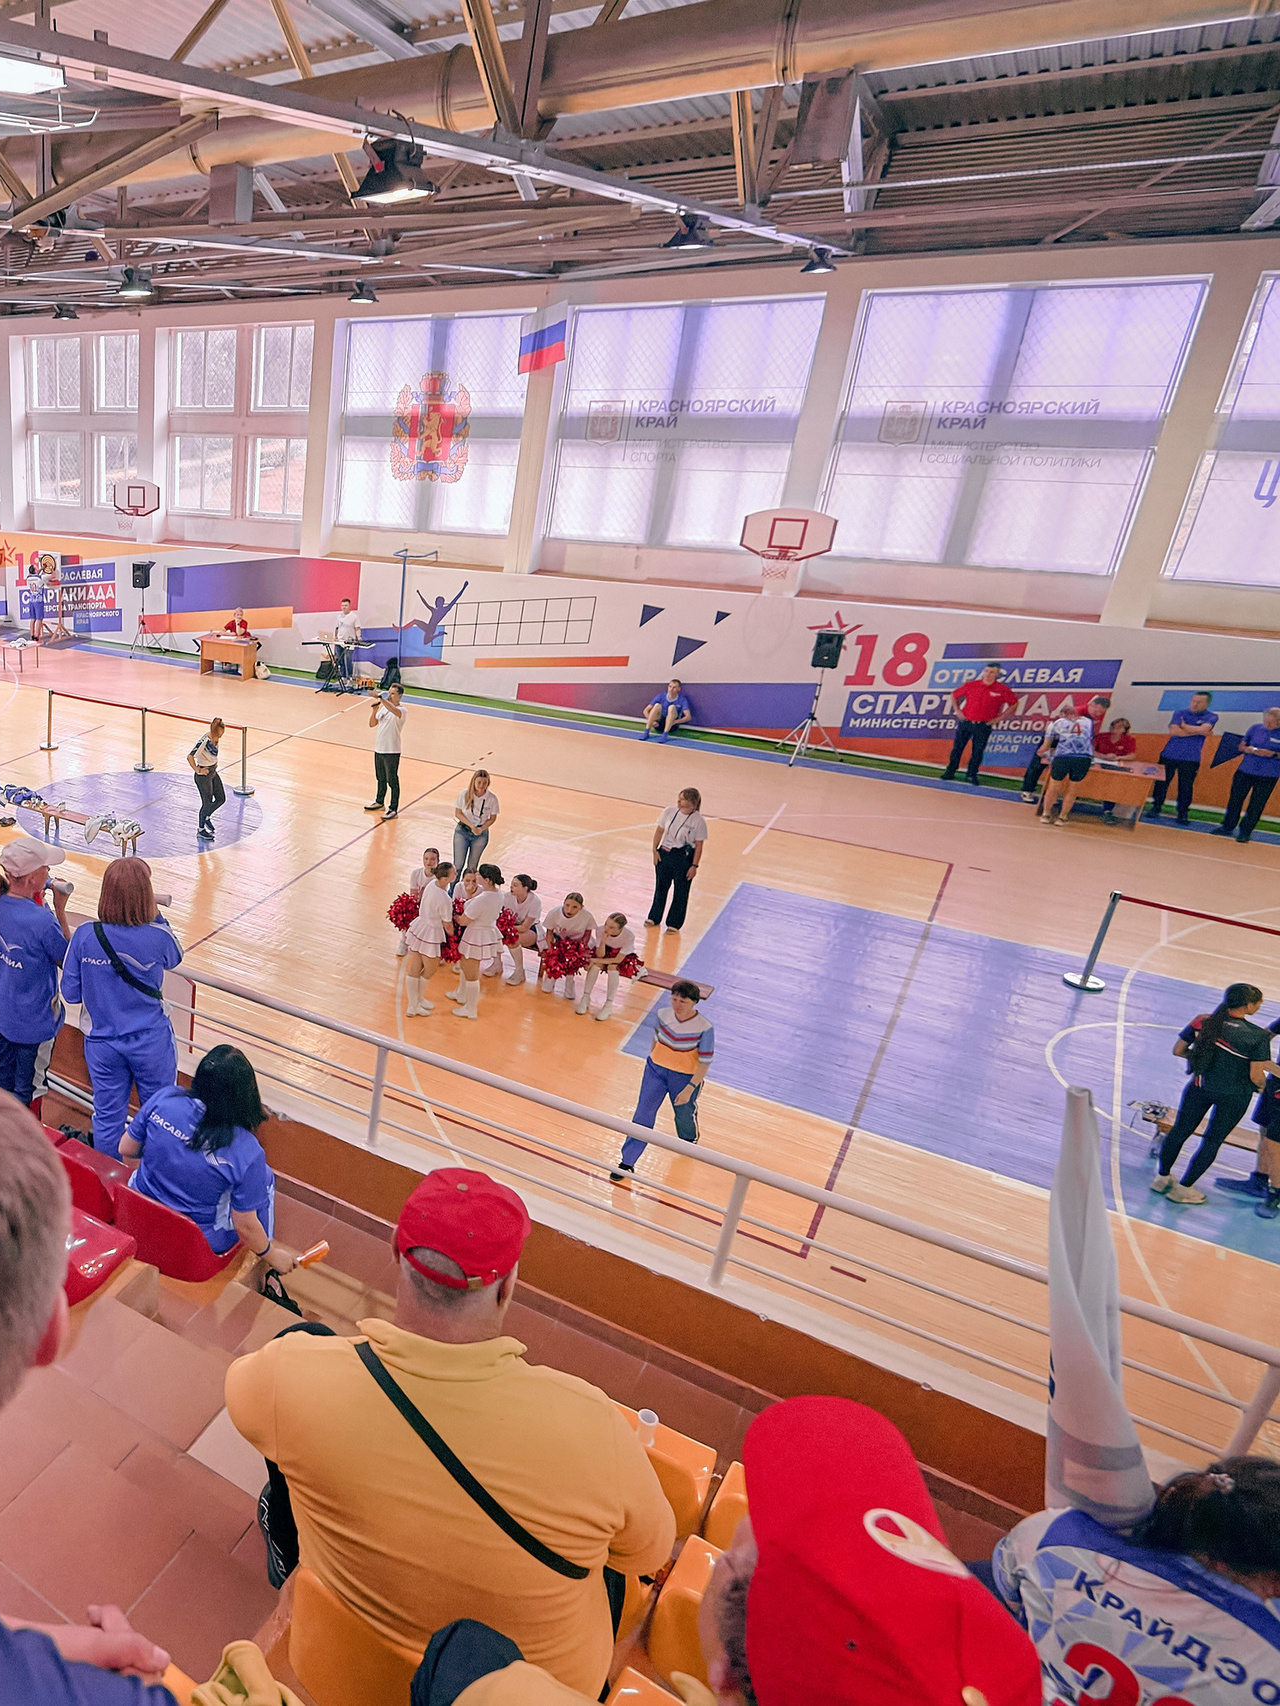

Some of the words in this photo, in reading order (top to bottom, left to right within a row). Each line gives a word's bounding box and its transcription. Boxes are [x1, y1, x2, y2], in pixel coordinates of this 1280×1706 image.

[637, 396, 776, 412] КРАСНОЯРСКИЙ
[940, 399, 1100, 414] КРАСНОЯРСКИЙ
[635, 413, 678, 428] КРАЙ
[937, 415, 986, 430] КРАЙ
[929, 440, 1040, 451] МИНИСТЕРСТВО
[926, 453, 1021, 467] СОЦИАЛЬНОЙ
[1022, 455, 1101, 468] ПОЛИТИКИ
[843, 632, 931, 687] 18
[848, 718, 959, 730] МИНИСТЕРСТВ
[985, 745, 1019, 754] КРАЯ
